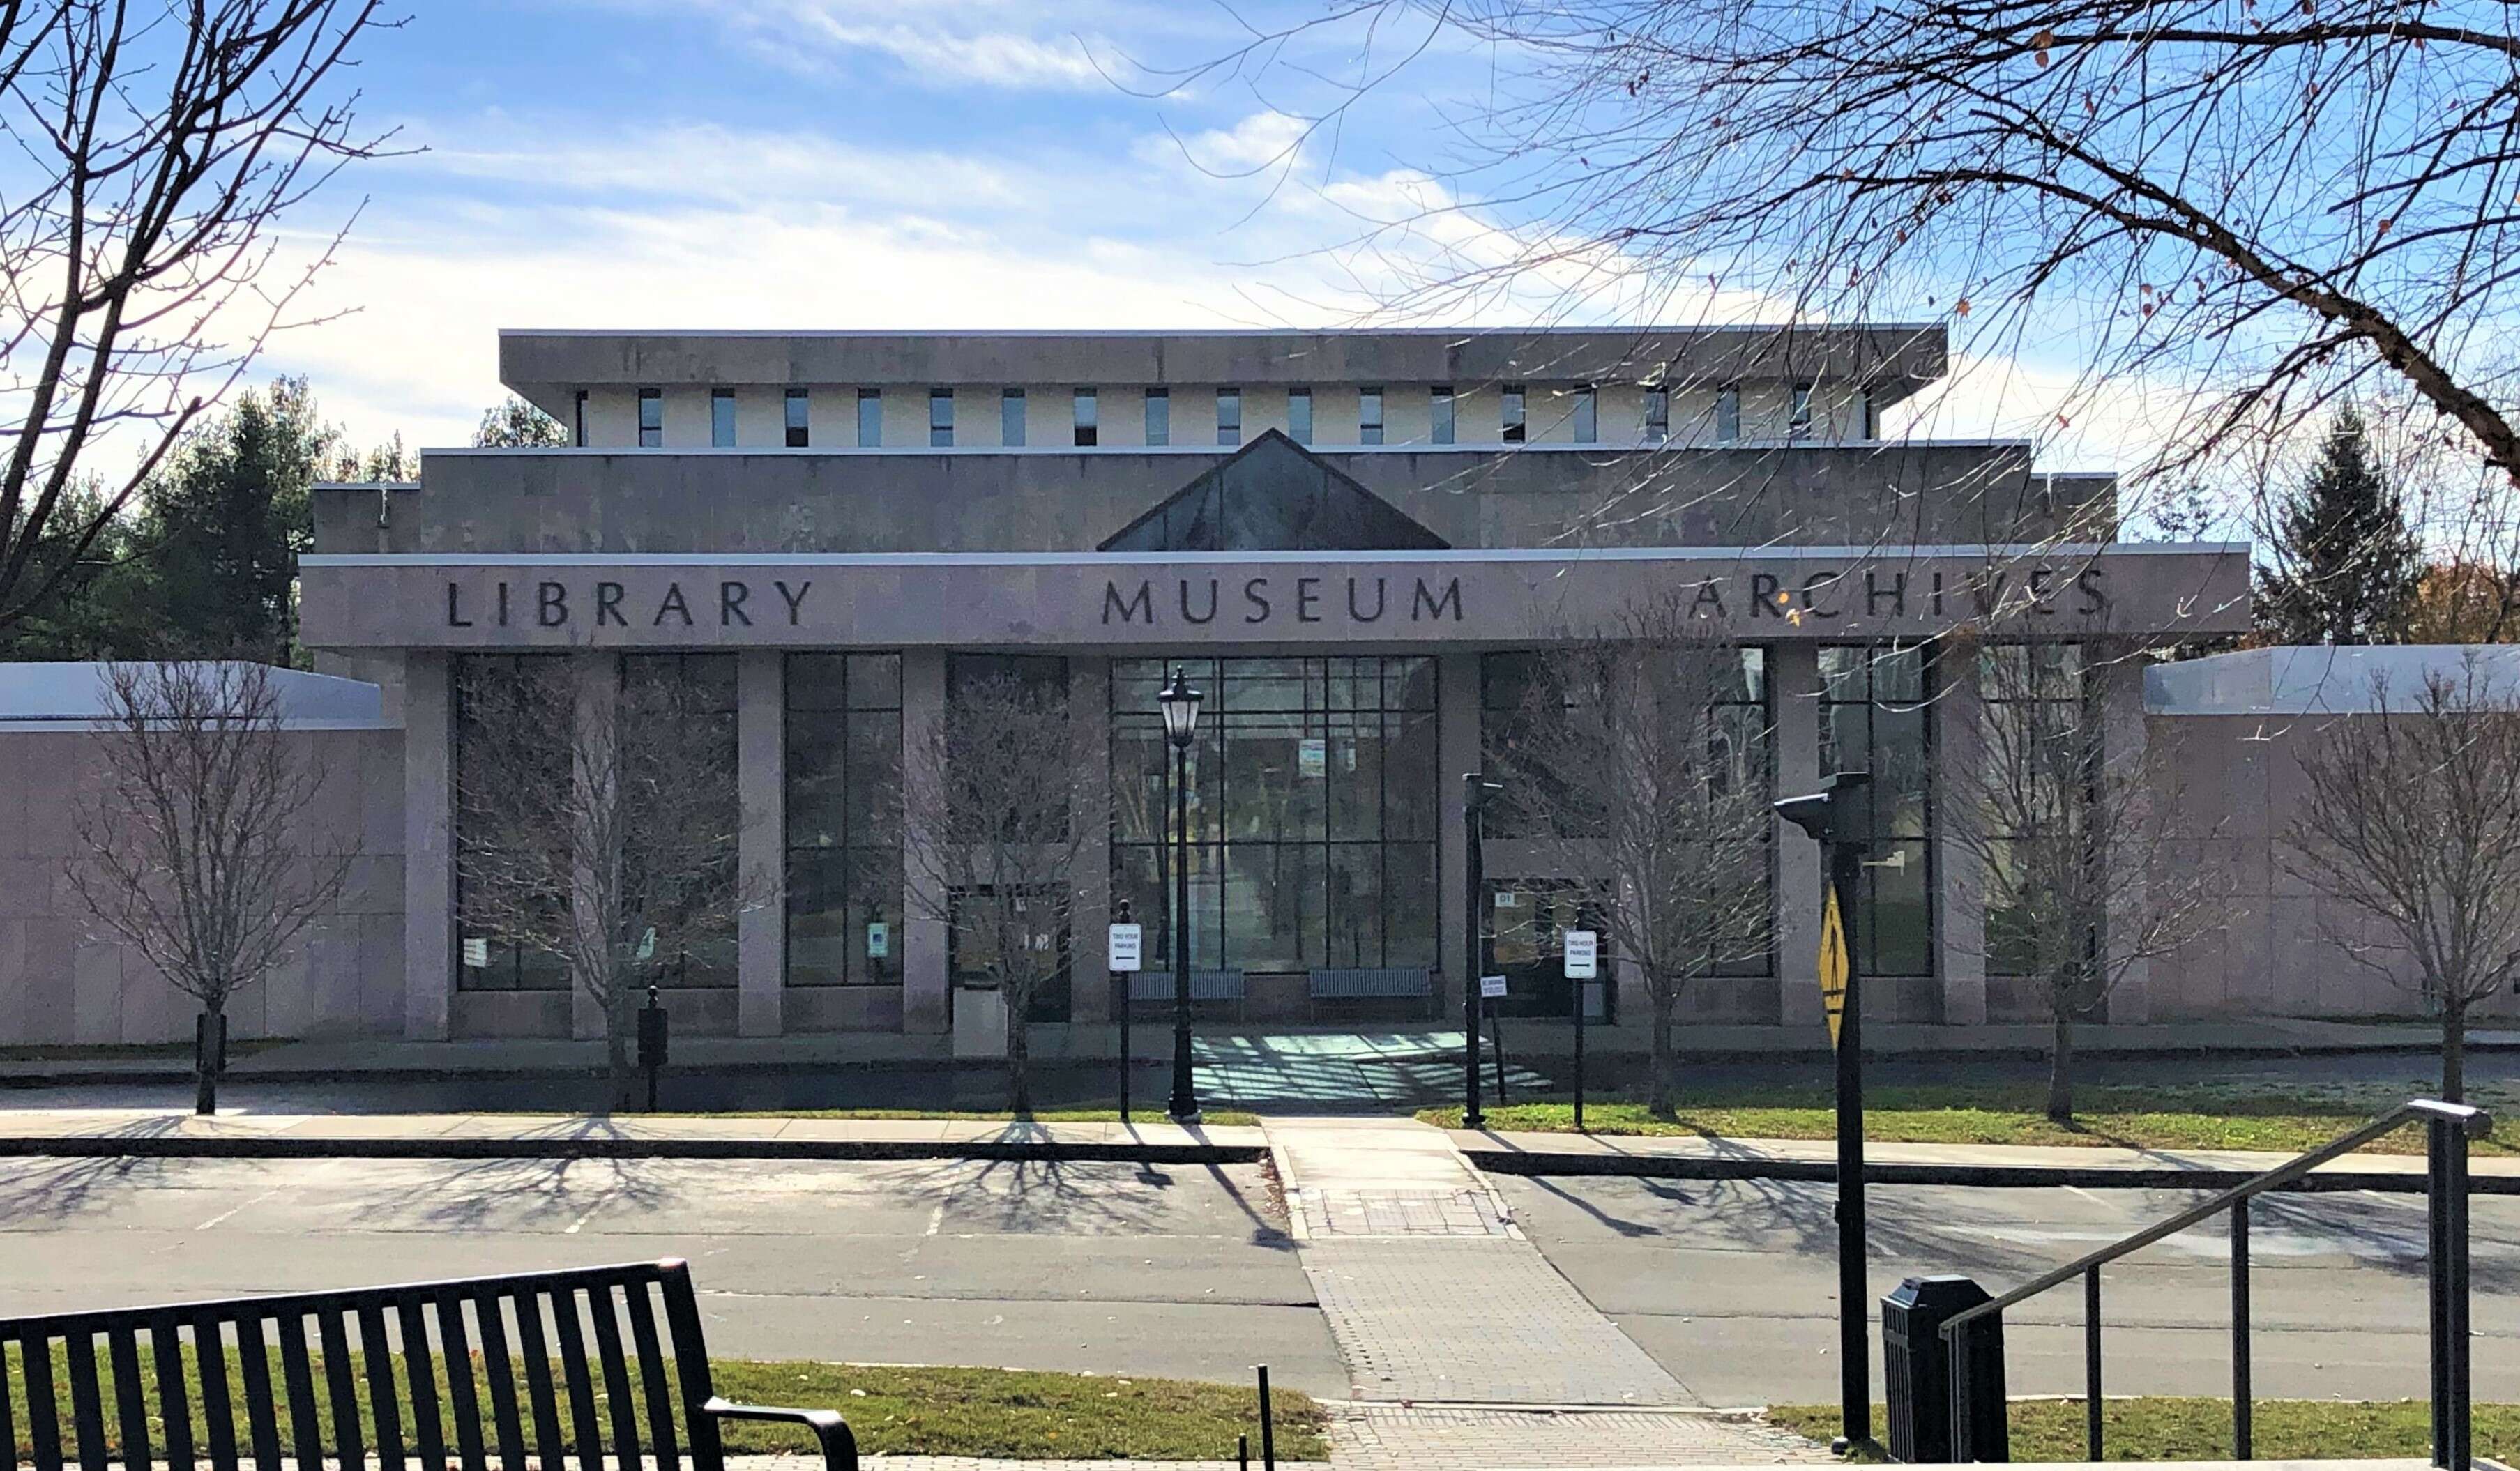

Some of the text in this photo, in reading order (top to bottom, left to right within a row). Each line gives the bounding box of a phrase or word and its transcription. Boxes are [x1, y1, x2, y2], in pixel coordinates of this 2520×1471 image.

[447, 570, 2107, 627] LIBRARY MUSEUM ARCHIVES
